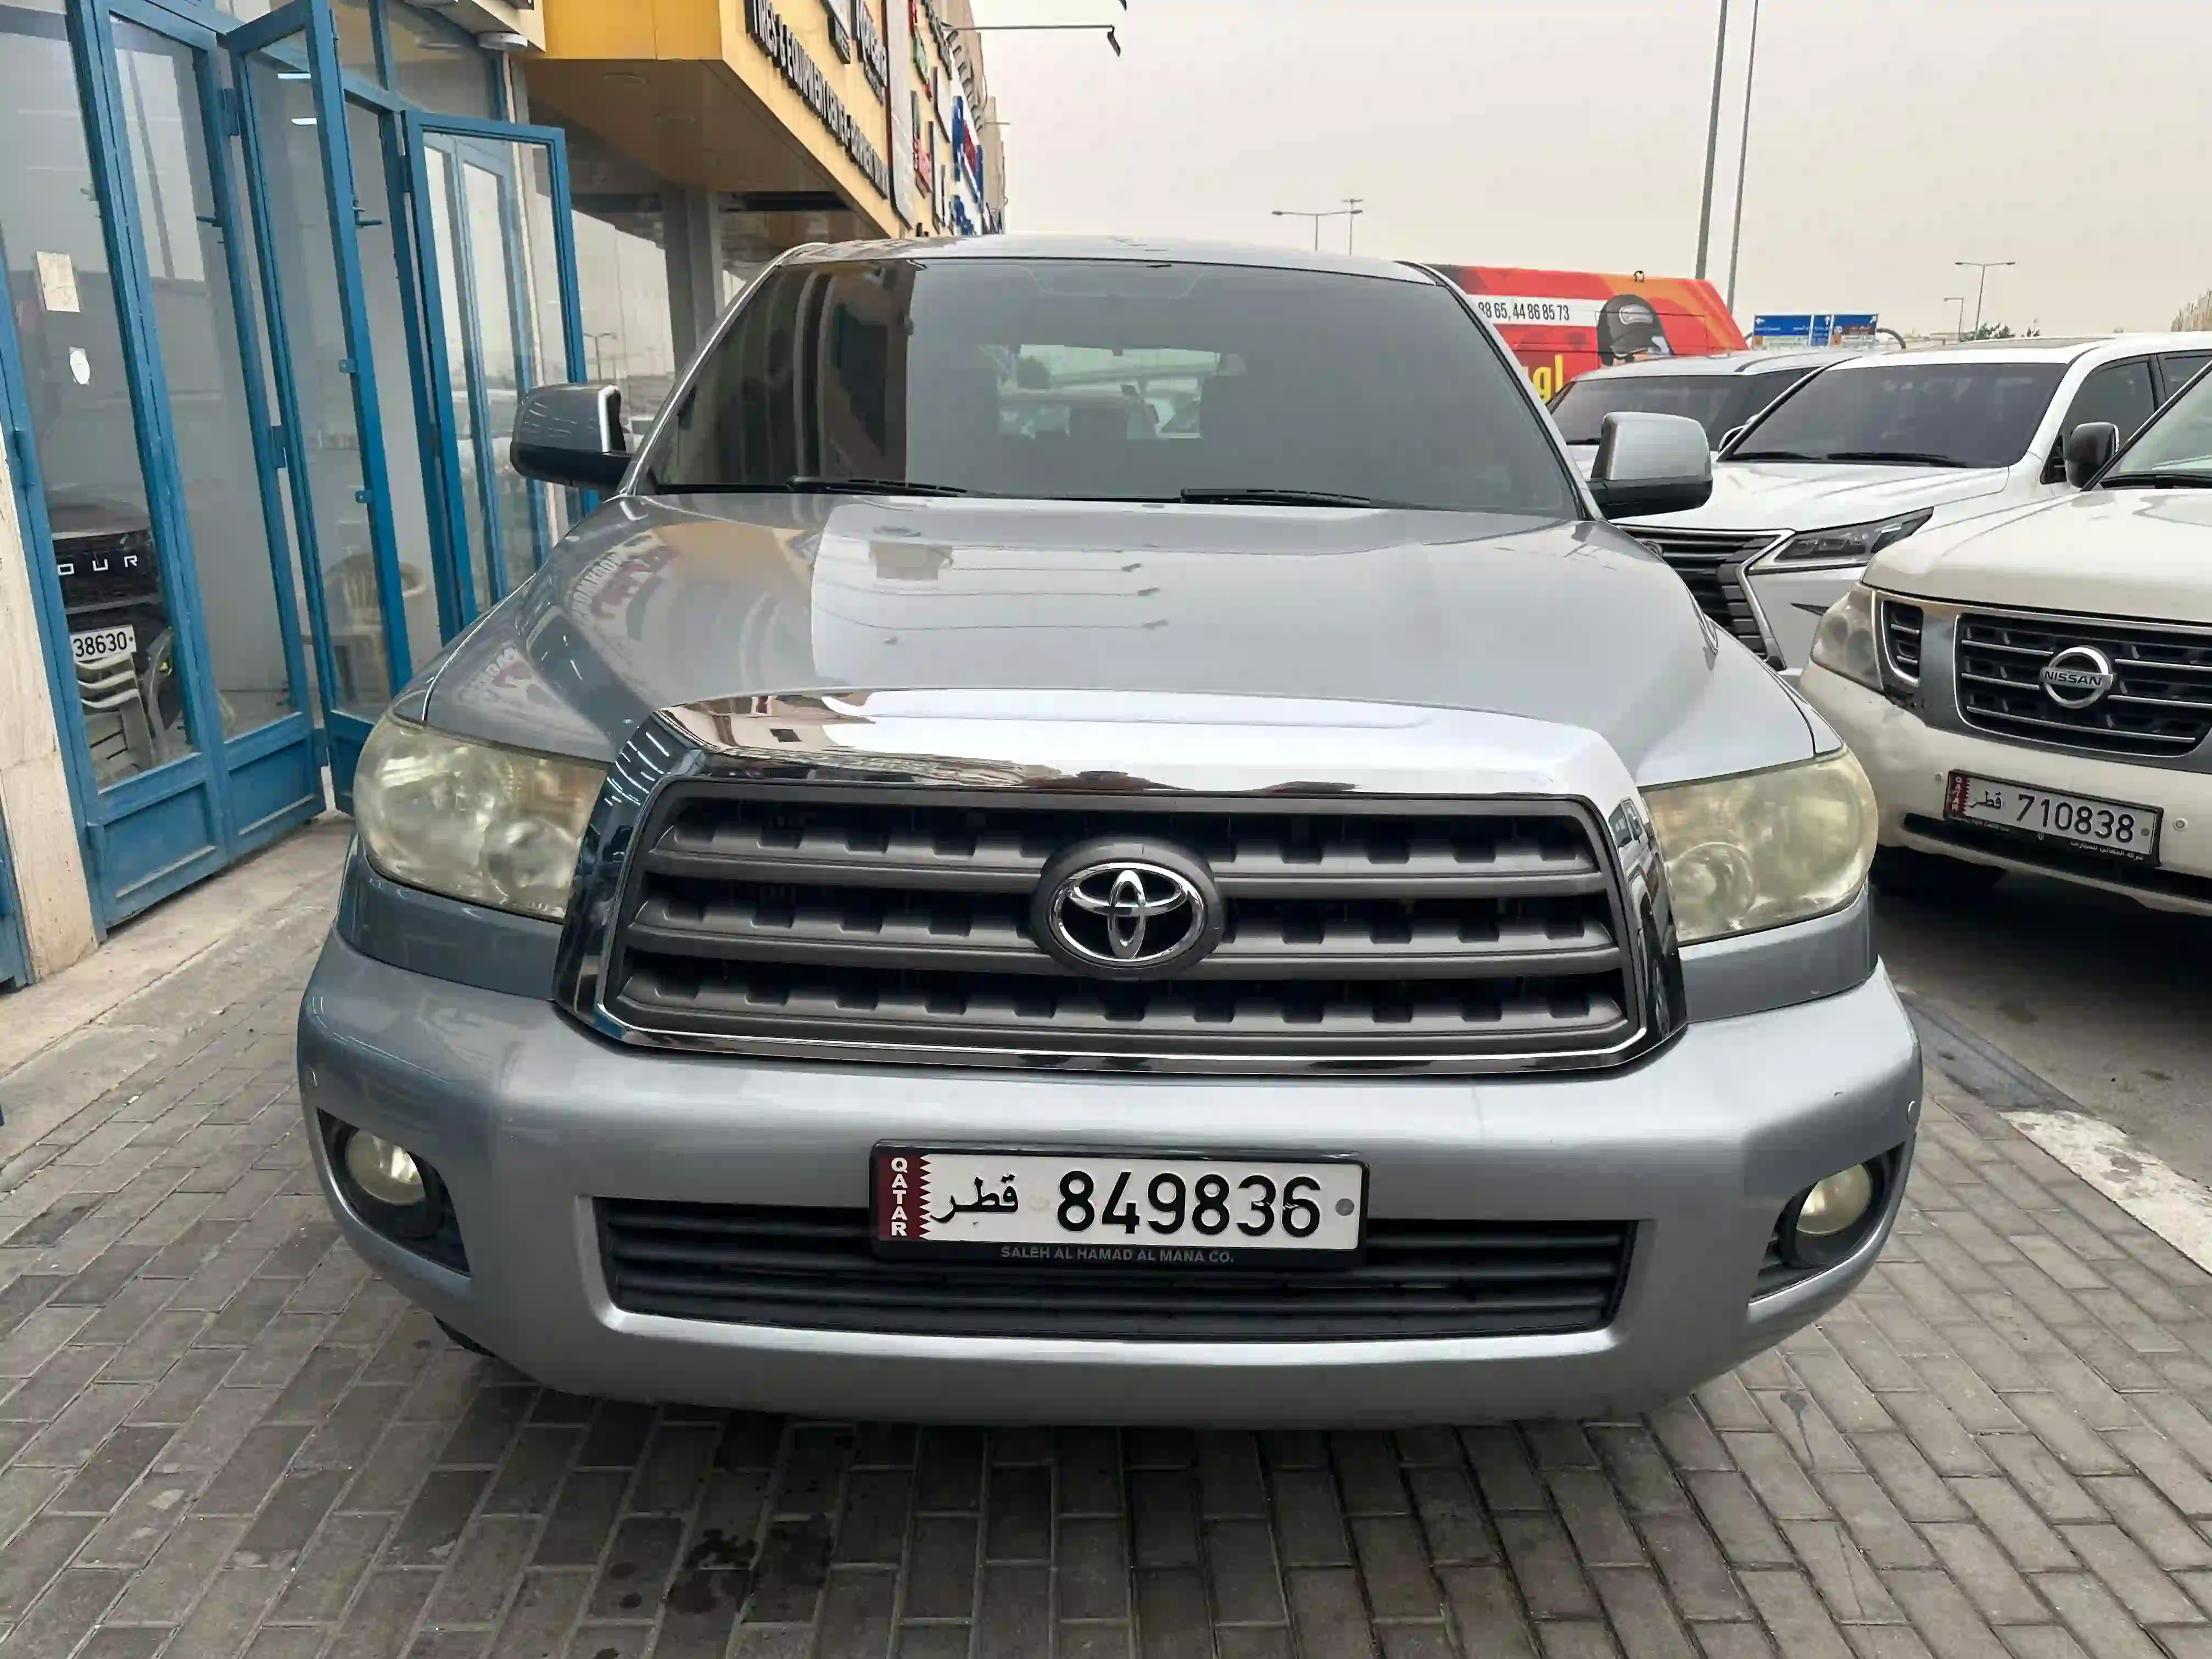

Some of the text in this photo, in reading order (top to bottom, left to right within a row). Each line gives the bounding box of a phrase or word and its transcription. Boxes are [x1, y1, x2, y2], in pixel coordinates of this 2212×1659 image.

[1512, 303, 1526, 320] 44
[1527, 303, 1540, 320] 86
[1542, 304, 1555, 321] 85
[1557, 304, 1569, 321] 73
[72, 631, 127, 657] 38630
[2043, 671, 2103, 686] NISSAN
[1968, 790, 2002, 809] قطر
[2016, 793, 2135, 844] 710838
[890, 1157, 908, 1237] QATAR
[930, 1172, 1019, 1224] قطر
[1055, 1170, 1322, 1238] 849836
[1001, 1245, 1235, 1264] SALEH AL HAMAD AL MANA CO.
